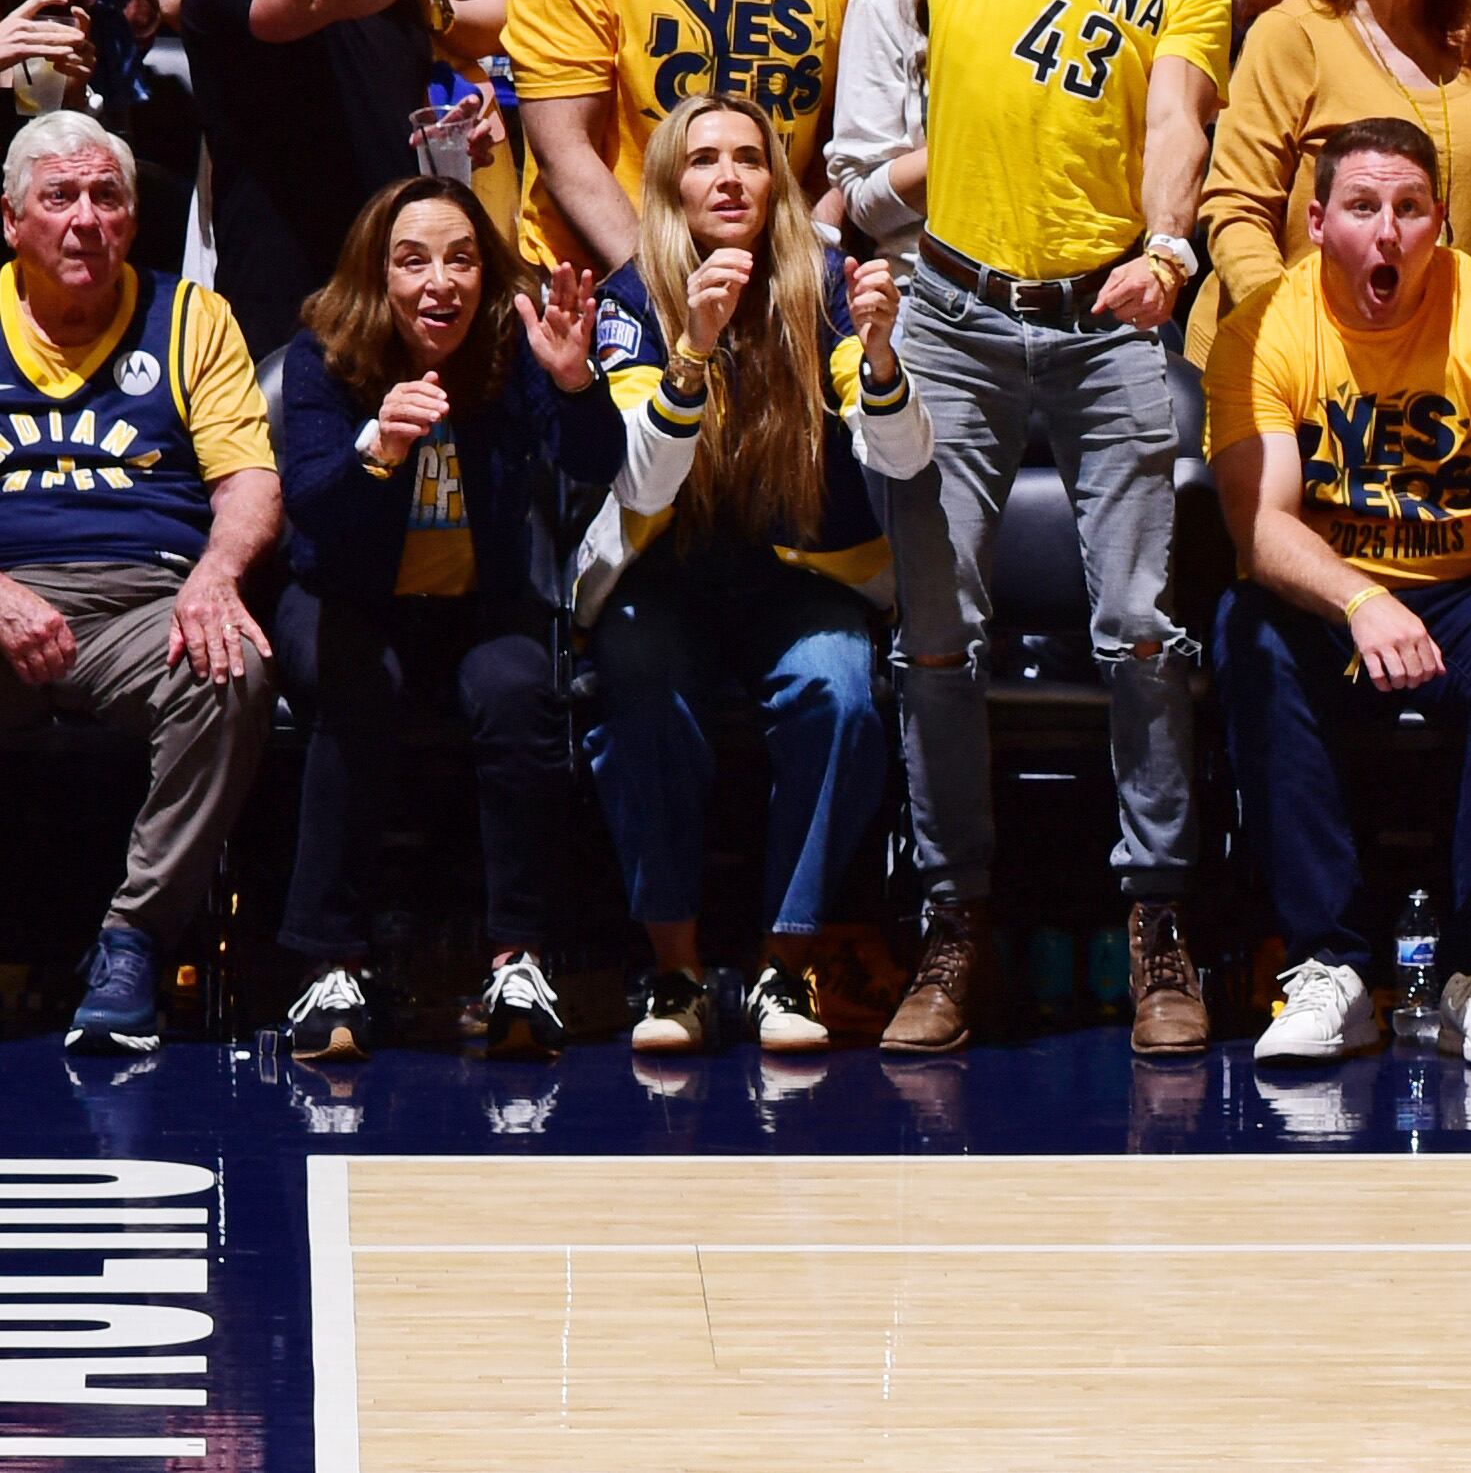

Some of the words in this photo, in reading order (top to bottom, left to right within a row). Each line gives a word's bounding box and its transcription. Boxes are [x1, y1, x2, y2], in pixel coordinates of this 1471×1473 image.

[1326, 391, 1461, 467] YES
[1328, 520, 1388, 559] 2025
[1392, 518, 1466, 561] FINALS
